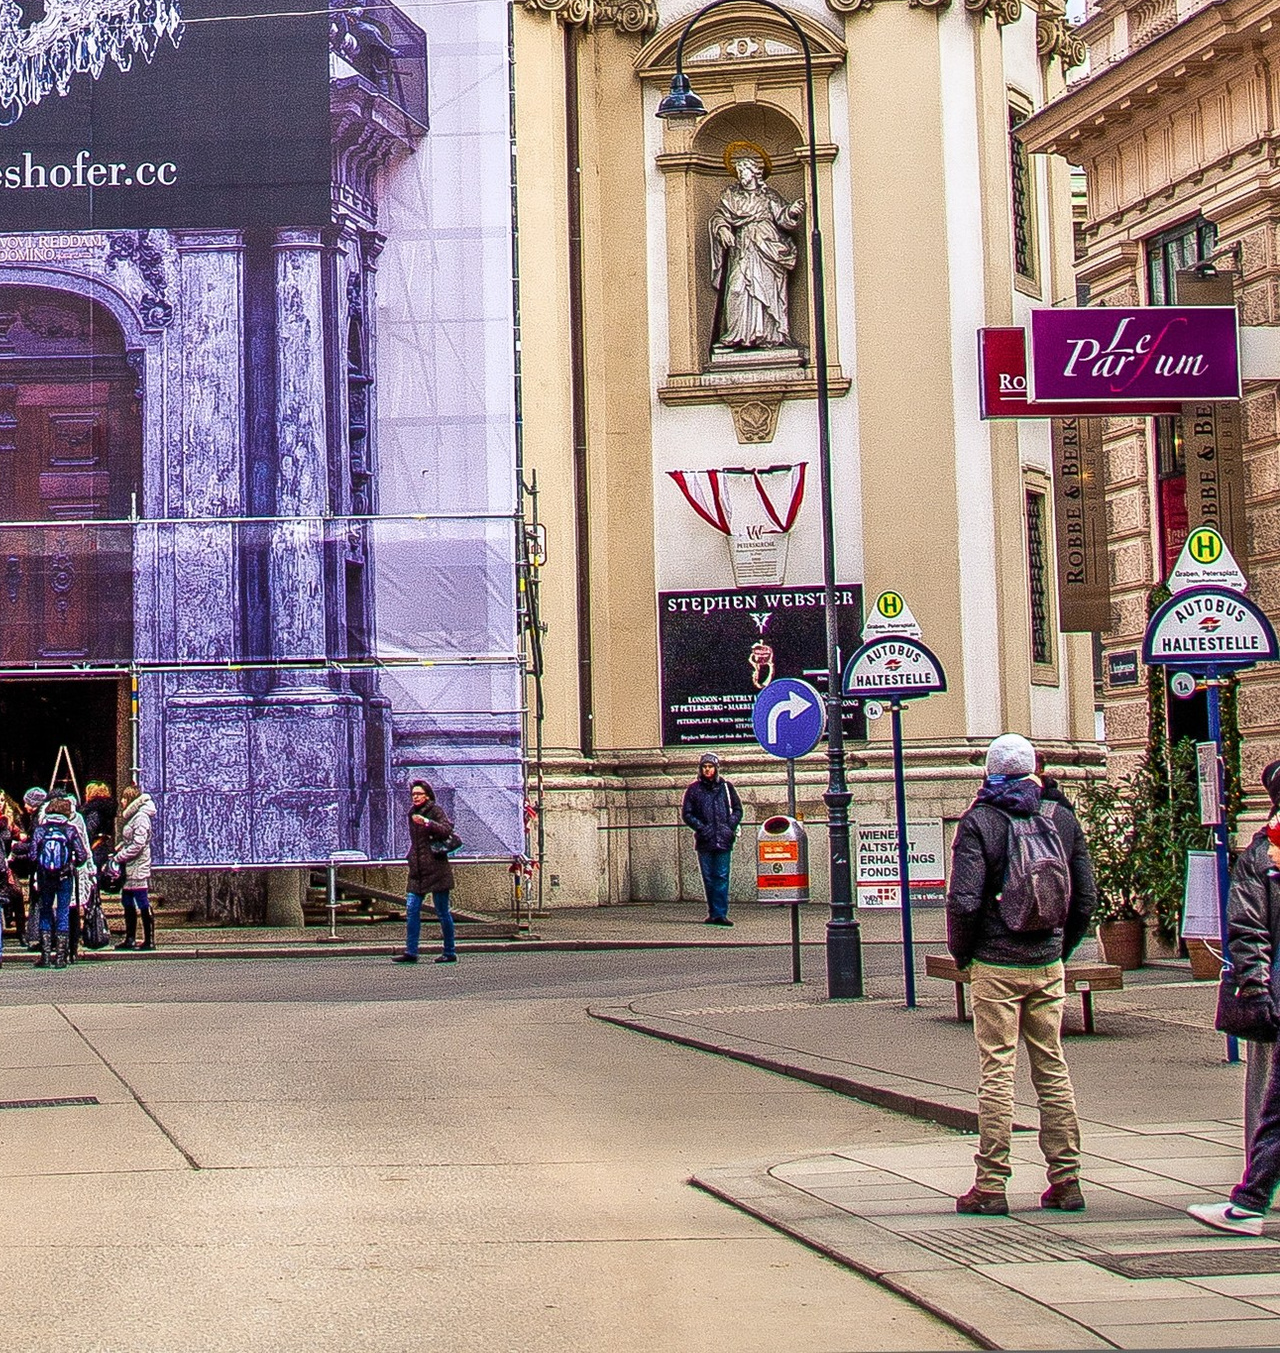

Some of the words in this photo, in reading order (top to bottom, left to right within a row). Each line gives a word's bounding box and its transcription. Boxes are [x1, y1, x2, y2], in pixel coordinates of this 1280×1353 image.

[1101, 317, 1151, 355] Le
[1063, 318, 1209, 392] Parfum
[1200, 471, 1219, 530] OBBE
[1067, 507, 1085, 585] ROBBE
[667, 594, 758, 615] STEPHEN
[1174, 598, 1246, 624] AUTOBUS
[1162, 635, 1259, 652] HALTESTELLE
[865, 644, 921, 665] AUTOBUS
[856, 672, 931, 687] HALTESTELLE
[859, 842, 916, 853] ALTSTAT
[860, 853, 936, 865] ERHALNGS
[860, 867, 899, 877] FONDS
